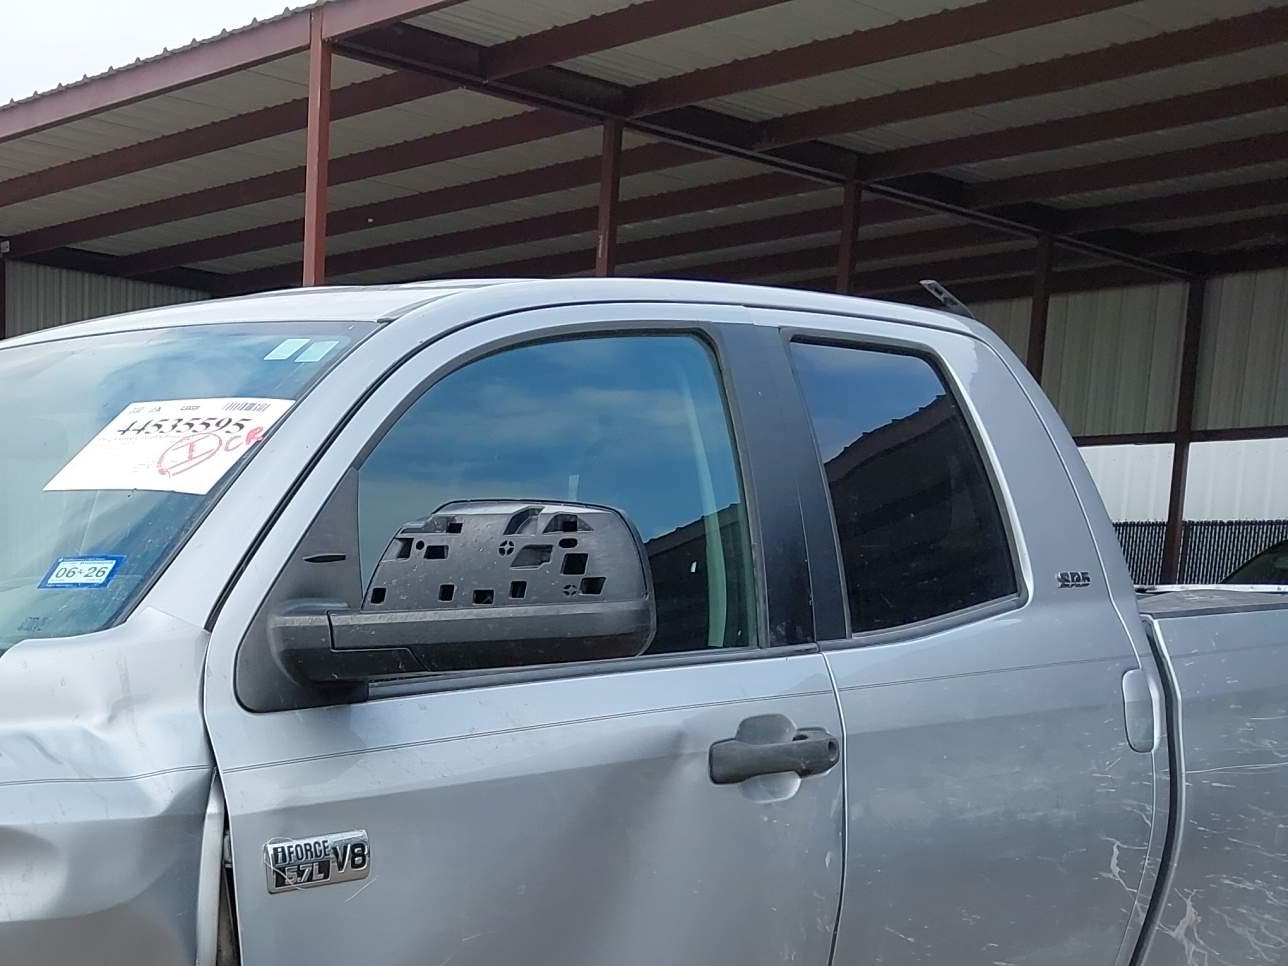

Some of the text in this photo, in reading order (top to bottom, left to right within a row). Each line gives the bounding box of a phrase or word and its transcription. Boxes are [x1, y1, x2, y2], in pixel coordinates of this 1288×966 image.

[116, 417, 253, 436] 44535595
[332, 842, 368, 873] V8
[284, 862, 325, 885] 5.7L
